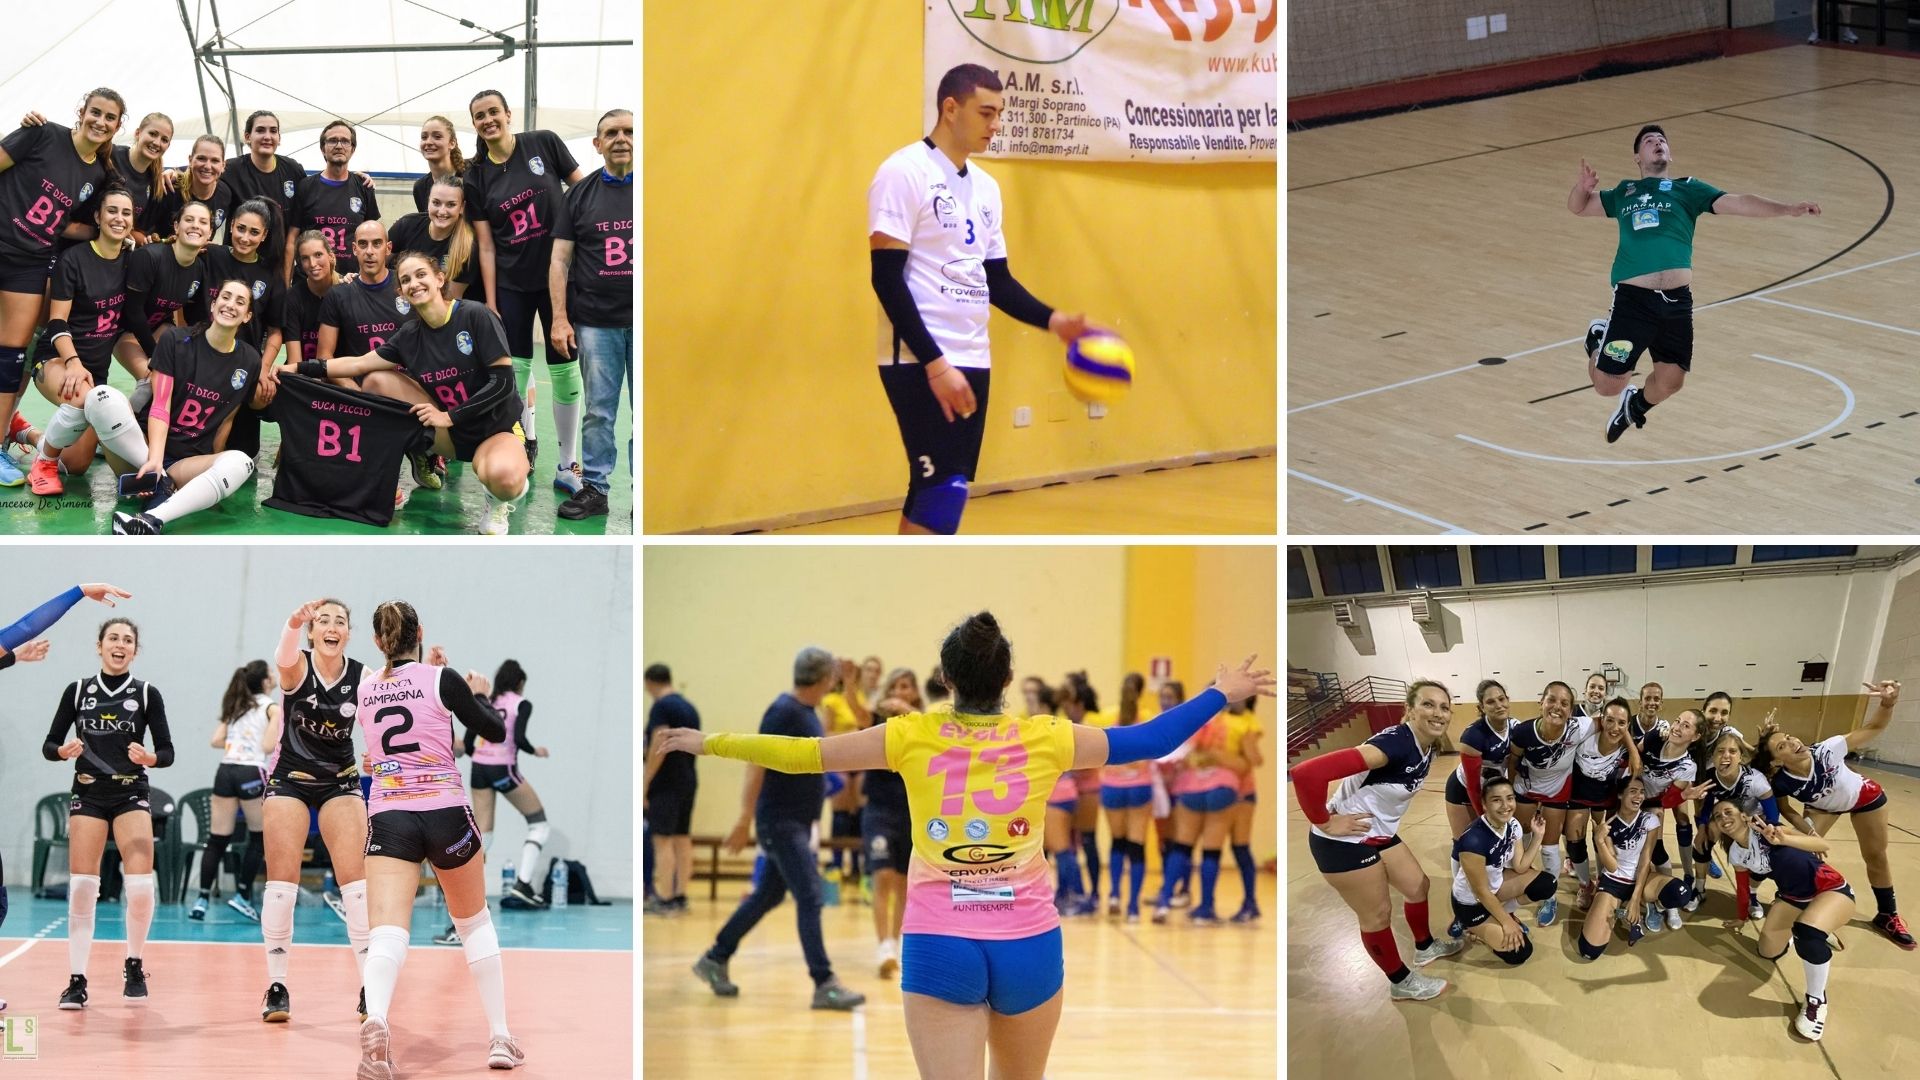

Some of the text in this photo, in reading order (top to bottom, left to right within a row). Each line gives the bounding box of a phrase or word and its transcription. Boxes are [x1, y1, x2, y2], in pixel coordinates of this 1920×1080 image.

[1009, 96, 1039, 112] Margi
[1042, 98, 1086, 112] Soprano
[1056, 113, 1101, 128] Partinico
[1103, 116, 1121, 130] (PA)
[1125, 99, 1234, 127] Concessionaria
[1237, 107, 1265, 133] per
[995, 126, 1075, 140] el. 091 8781734
[1009, 140, 1090, 156] info@mam-srl.it
[1129, 133, 1200, 153] Responsabile
[1202, 135, 1247, 150] Vendite.
[42, 178, 54, 192] TE
[499, 200, 511, 212] TE
[25, 195, 65, 235] B1
[315, 216, 325, 225] TE
[509, 202, 542, 236] B1
[596, 221, 610, 232] TE
[964, 218, 976, 245] 3
[94, 300, 107, 310] TE
[357, 324, 369, 334] TE
[420, 372, 433, 383] TE
[176, 398, 216, 430] B1
[311, 400, 371, 417] SUCA PICCIO
[317, 419, 362, 462] B1
[918, 454, 935, 478] 3
[340, 685, 352, 694] EP
[80, 696, 97, 711] 13
[363, 689, 425, 707] CAMPAGNA
[79, 718, 136, 733] TRINCA
[373, 705, 421, 756] 2
[926, 743, 1030, 816] 13
[1623, 839, 1636, 850] 18
[953, 903, 1015, 912] #UNITISEMPRE
